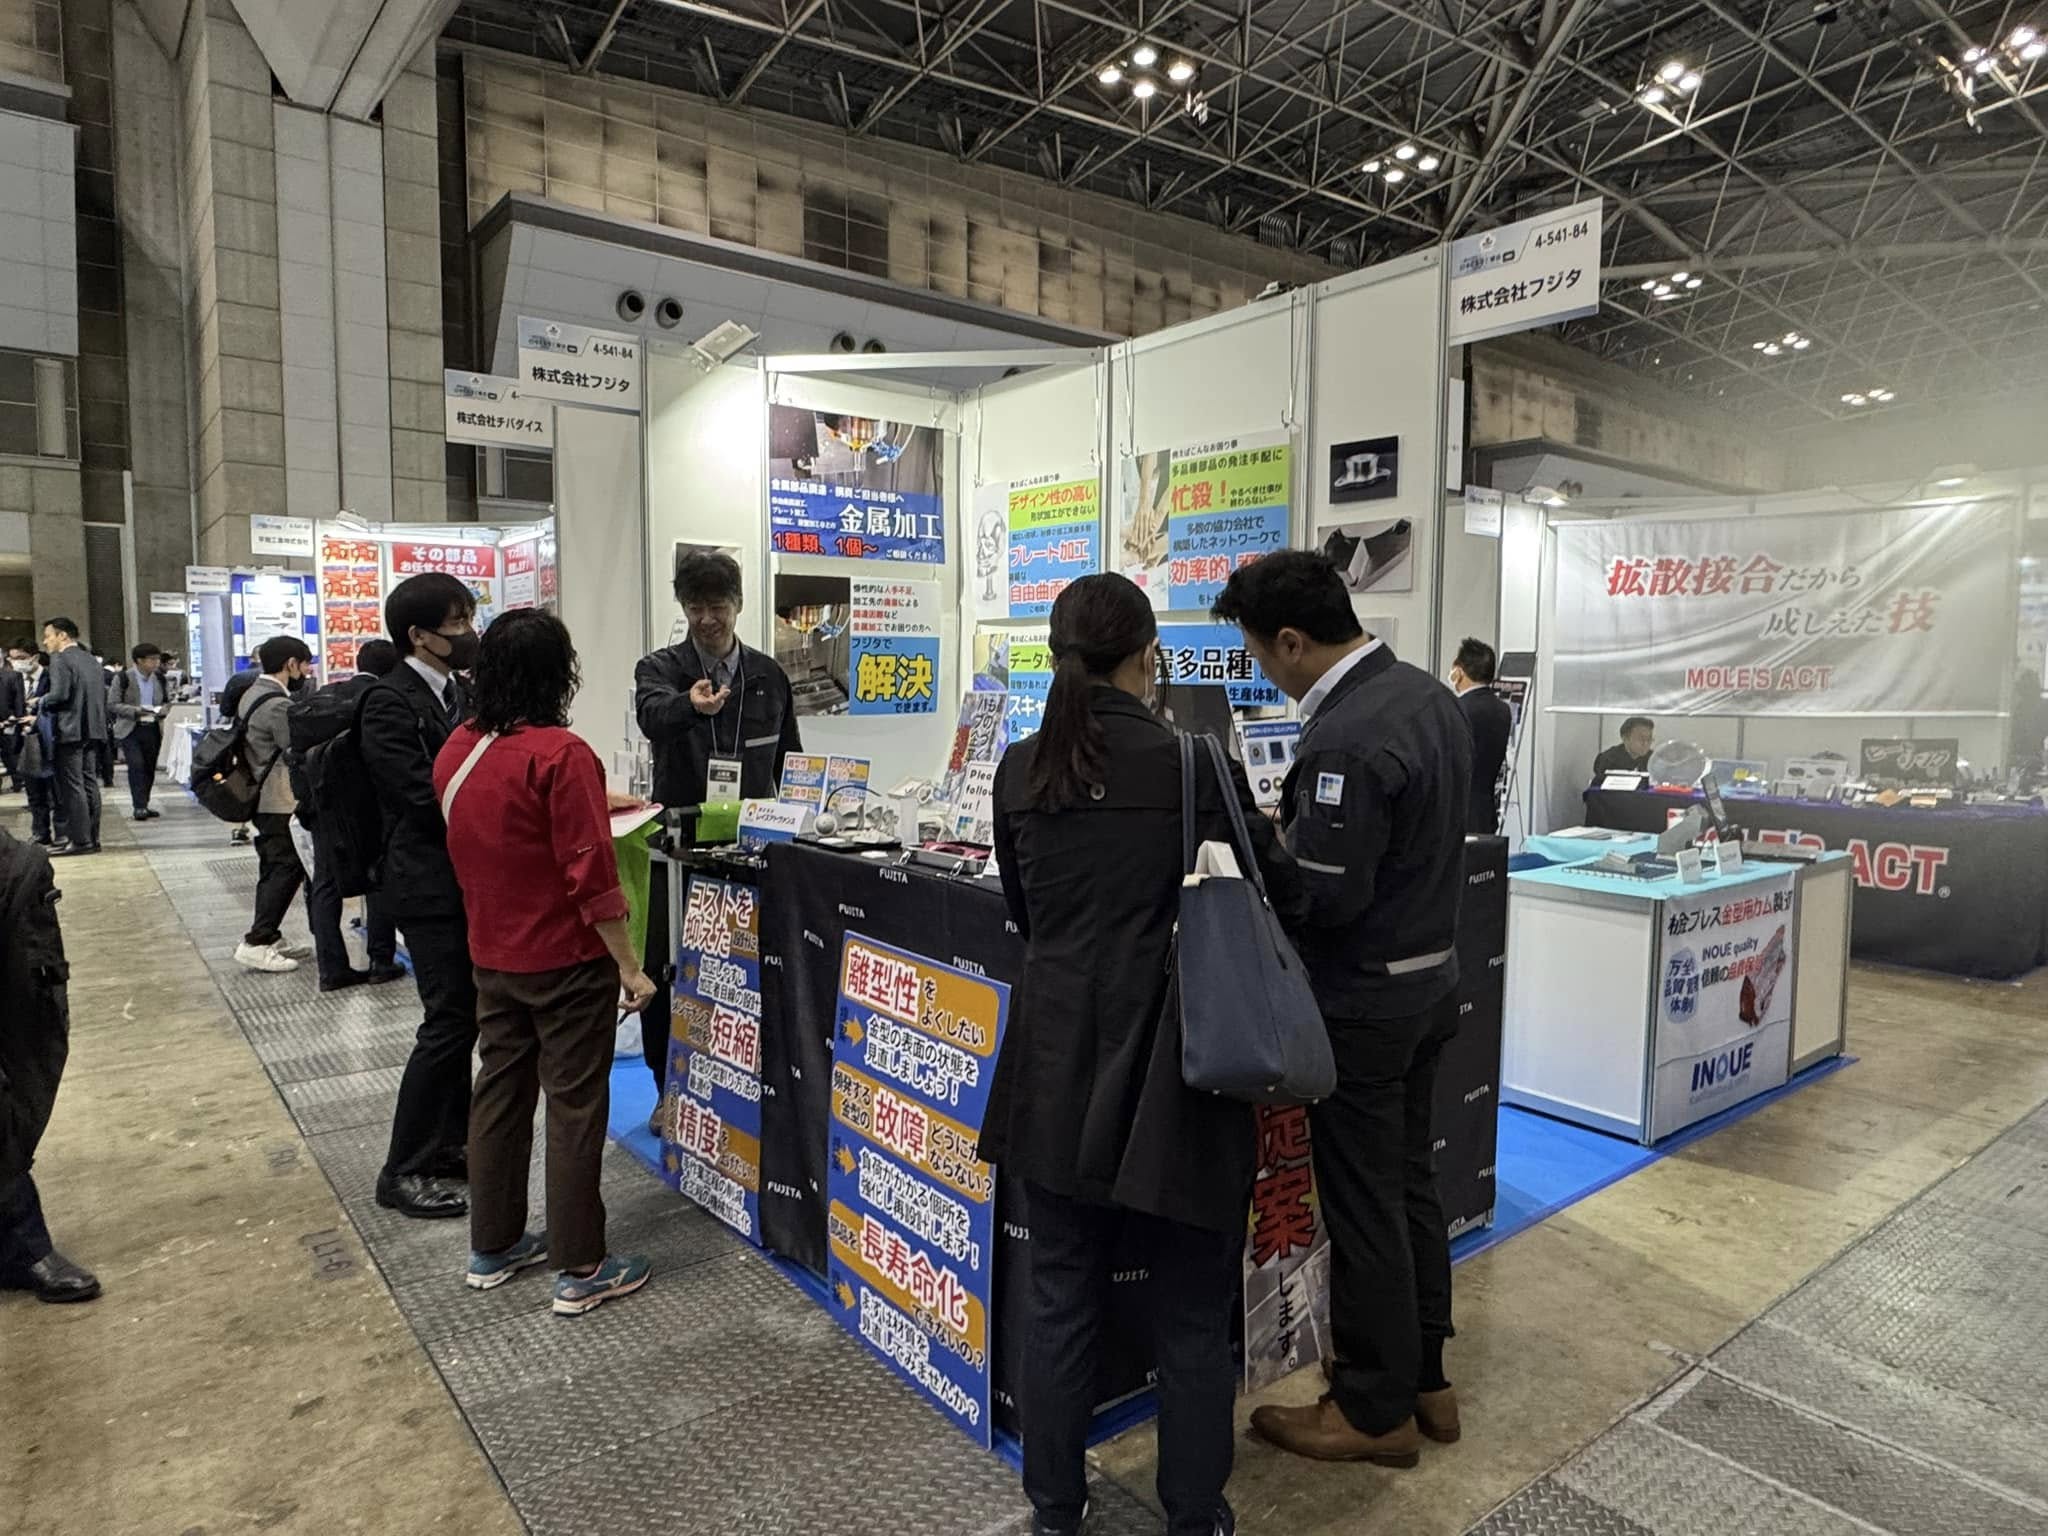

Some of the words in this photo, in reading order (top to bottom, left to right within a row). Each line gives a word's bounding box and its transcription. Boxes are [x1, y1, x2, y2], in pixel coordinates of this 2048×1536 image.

[1535, 220, 1588, 249] 4-541-84
[1460, 268, 1582, 316] 株式会社フジタ
[593, 343, 633, 360] 4-541-84
[532, 365, 630, 393] 株式会社フジタ
[456, 411, 544, 434] 株式会社チバダイス
[1172, 449, 1284, 478] 多品種部品の発注手配に
[1009, 485, 1097, 512] デザイン性の高い
[1171, 480, 1227, 513] 忙殺！
[1230, 482, 1283, 497] やるべき仕事が
[838, 503, 942, 540] 金属加工
[1187, 515, 1265, 537] 多数の協力会社で
[411, 545, 478, 564] その部品
[1009, 539, 1090, 567] プレート加工
[1173, 530, 1281, 552] 構築したネットワークで
[1606, 553, 1862, 598] 拡散接合だから
[1009, 581, 1071, 605] 自由曲面
[853, 623, 932, 634] 金属加工でお困りの方へ
[1760, 591, 1940, 640] 成しえた技
[852, 637, 893, 650] フジタで
[1010, 652, 1051, 669] データ
[855, 651, 933, 703] 解決
[1687, 666, 1772, 690] MOLE'S
[1780, 666, 1832, 690] ACT
[894, 702, 933, 714] できます。
[1229, 686, 1279, 704] 生産体制
[879, 868, 908, 884] FUJITA
[1468, 870, 1496, 885] FUJITA
[1848, 838, 1949, 895] ACT
[688, 880, 754, 929] コストを
[839, 903, 865, 919] FUJITA
[682, 911, 732, 959] 抑えた
[1702, 942, 1733, 962] INOUE
[1733, 937, 1759, 958] quality
[953, 956, 986, 976] FUJITA
[1670, 996, 1695, 1014] 体制
[710, 1002, 760, 1074] 短縮
[920, 1003, 985, 1047] よくしたい
[866, 1013, 979, 1088] 金型の表面の状態を
[865, 1038, 960, 1107] 見直しましょう！
[1690, 1042, 1754, 1092] INOUE
[841, 1098, 871, 1130] 金型の
[874, 1090, 929, 1164] 故障
[676, 1094, 721, 1166] 精度
[929, 1149, 993, 1200] ならない？
[768, 1181, 802, 1200] FUJITA
[858, 1146, 971, 1234] 負荷がかかる個所を
[860, 1213, 969, 1334] 長寿命化
[912, 1302, 985, 1373] できないの？
